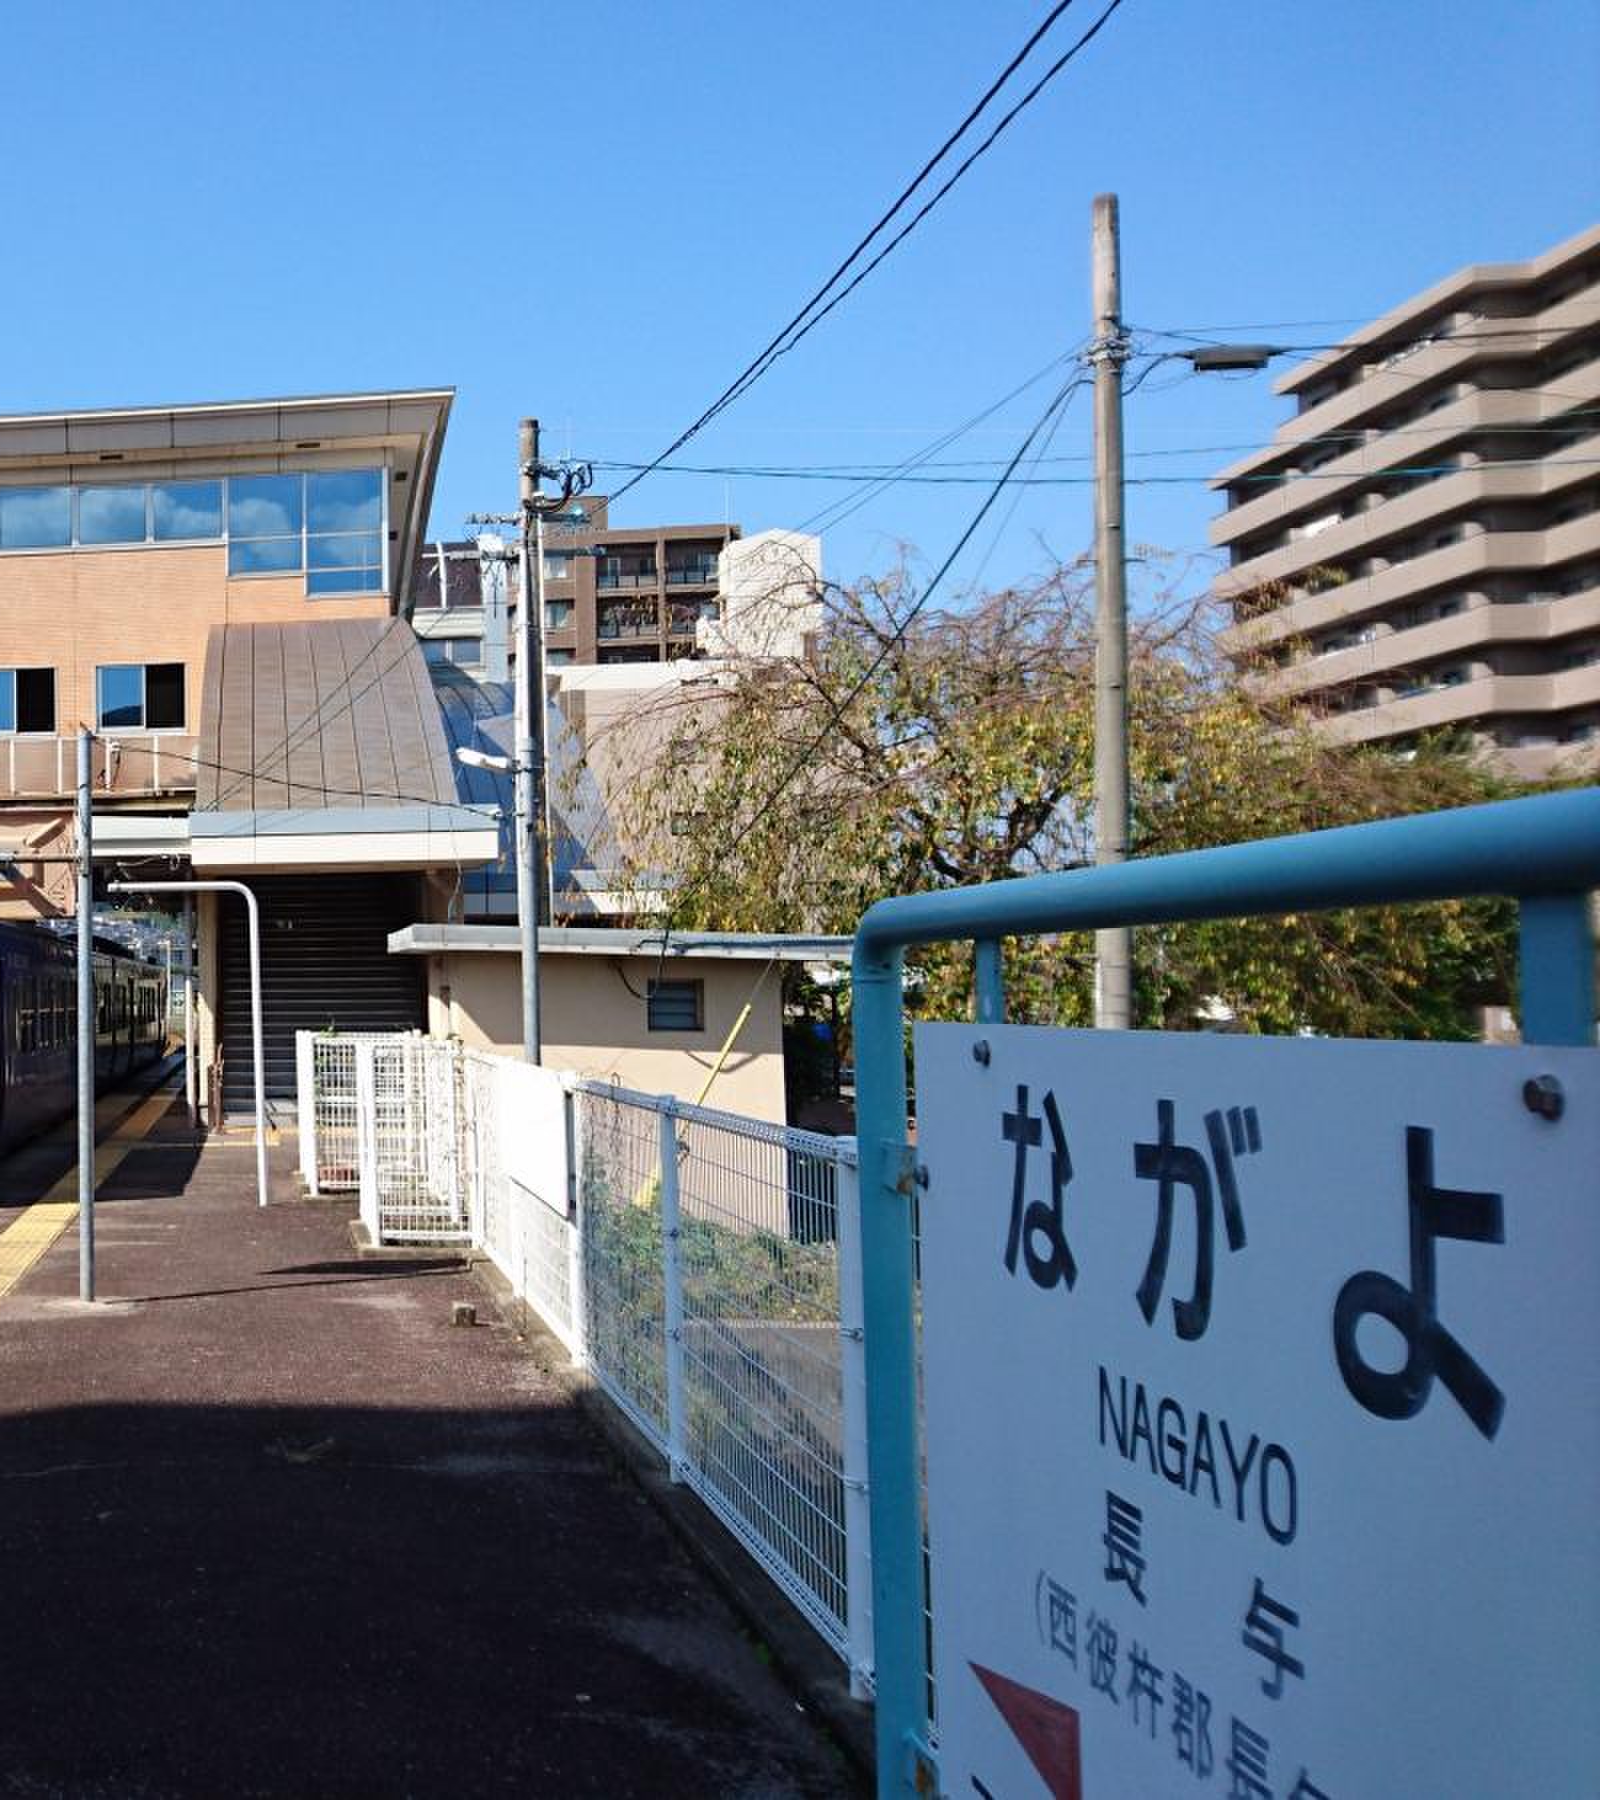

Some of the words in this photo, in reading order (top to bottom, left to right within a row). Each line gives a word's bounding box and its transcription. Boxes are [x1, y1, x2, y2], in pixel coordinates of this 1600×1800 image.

[1001, 1083, 1507, 1444] ながよ
[1098, 1364, 1298, 1547] NAGAYO
[1102, 1488, 1307, 1702] 長与
